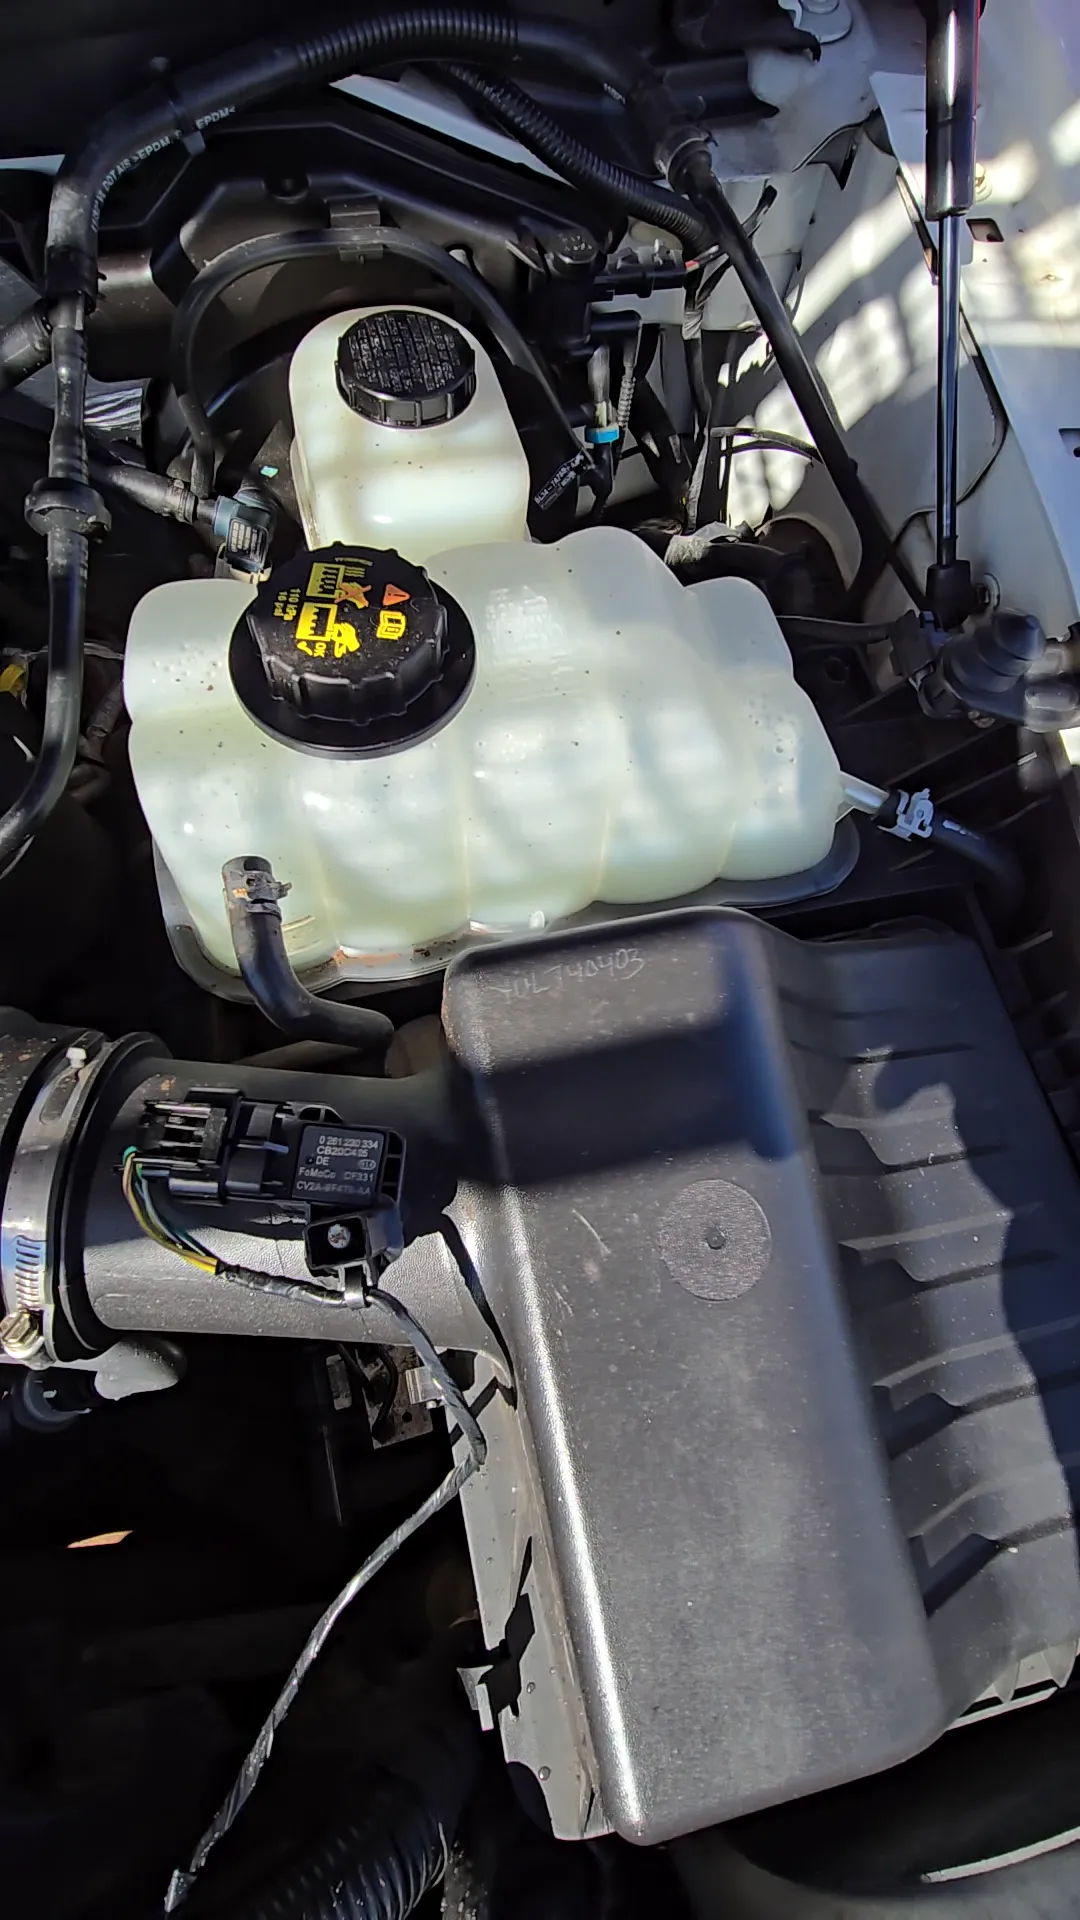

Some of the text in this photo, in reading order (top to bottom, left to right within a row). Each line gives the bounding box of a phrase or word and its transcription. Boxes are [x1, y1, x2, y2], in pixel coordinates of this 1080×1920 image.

[314, 642, 326, 657] OK
[319, 1135, 326, 1145] 0
[315, 1156, 330, 1166] DE
